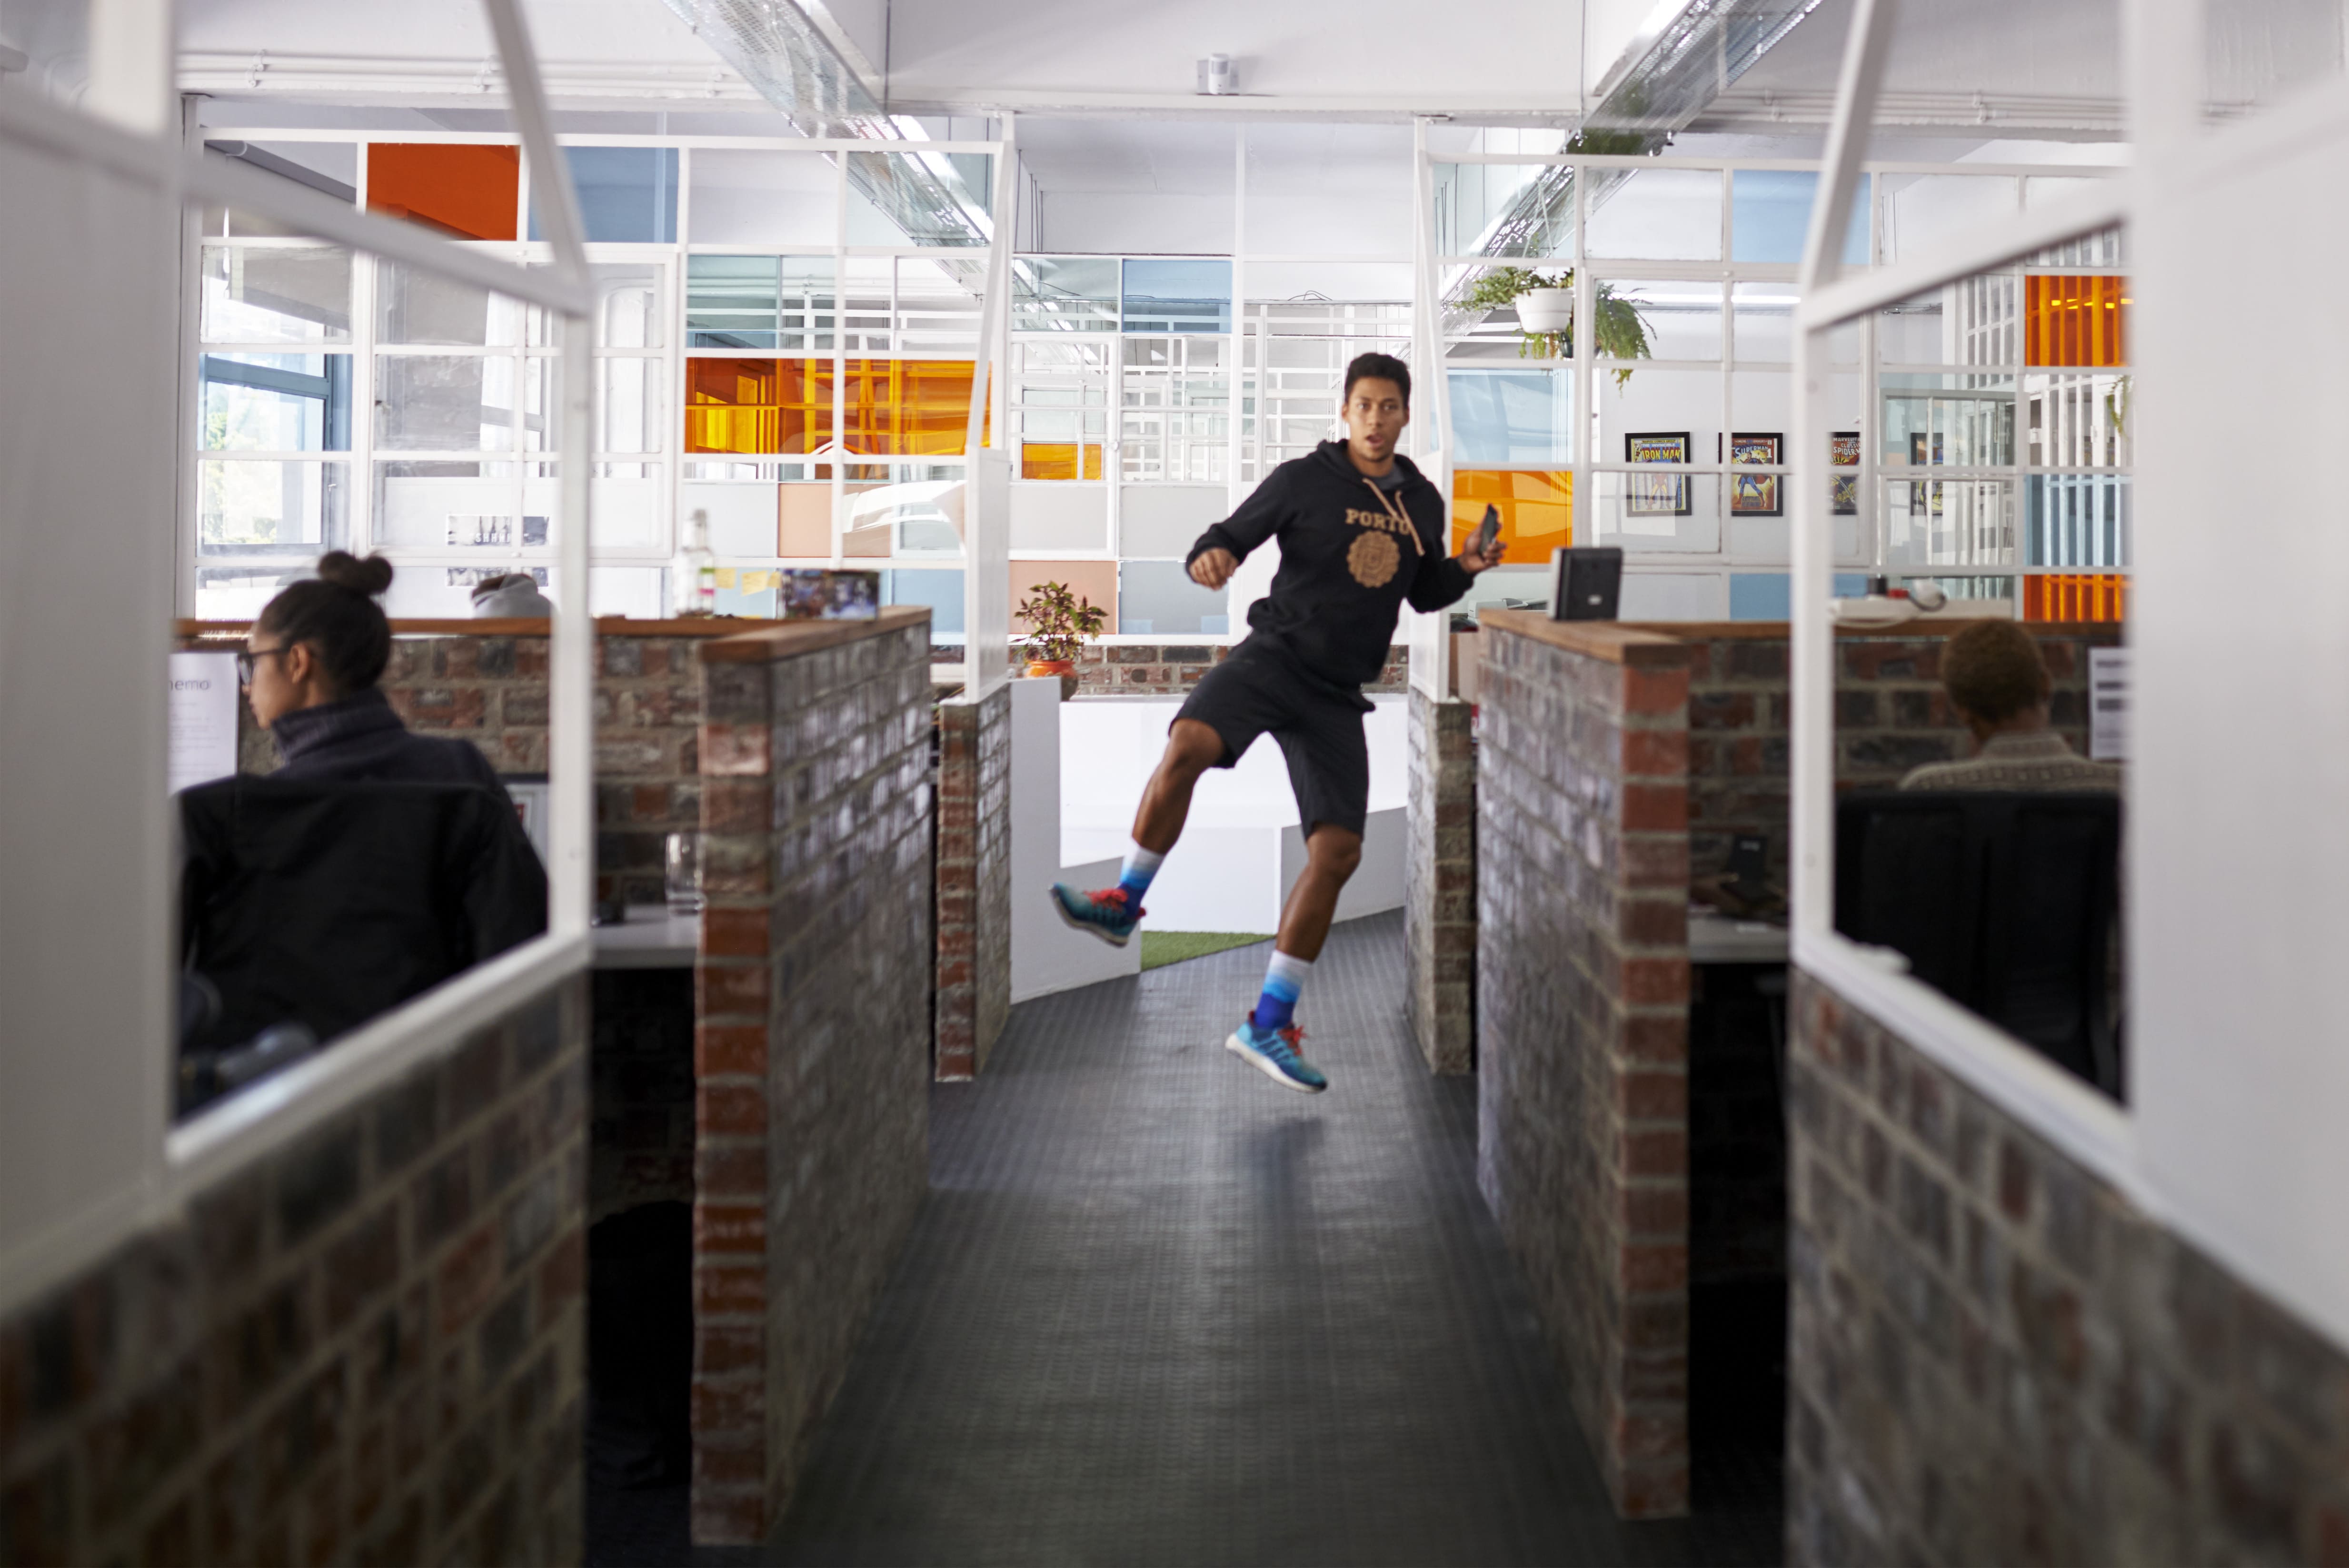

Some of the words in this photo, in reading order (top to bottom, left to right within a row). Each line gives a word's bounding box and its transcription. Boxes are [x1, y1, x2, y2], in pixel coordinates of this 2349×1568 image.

[1642, 448, 1661, 460] IRON
[1662, 447, 1681, 460] MAN
[1735, 446, 1768, 459] SUPERMAN
